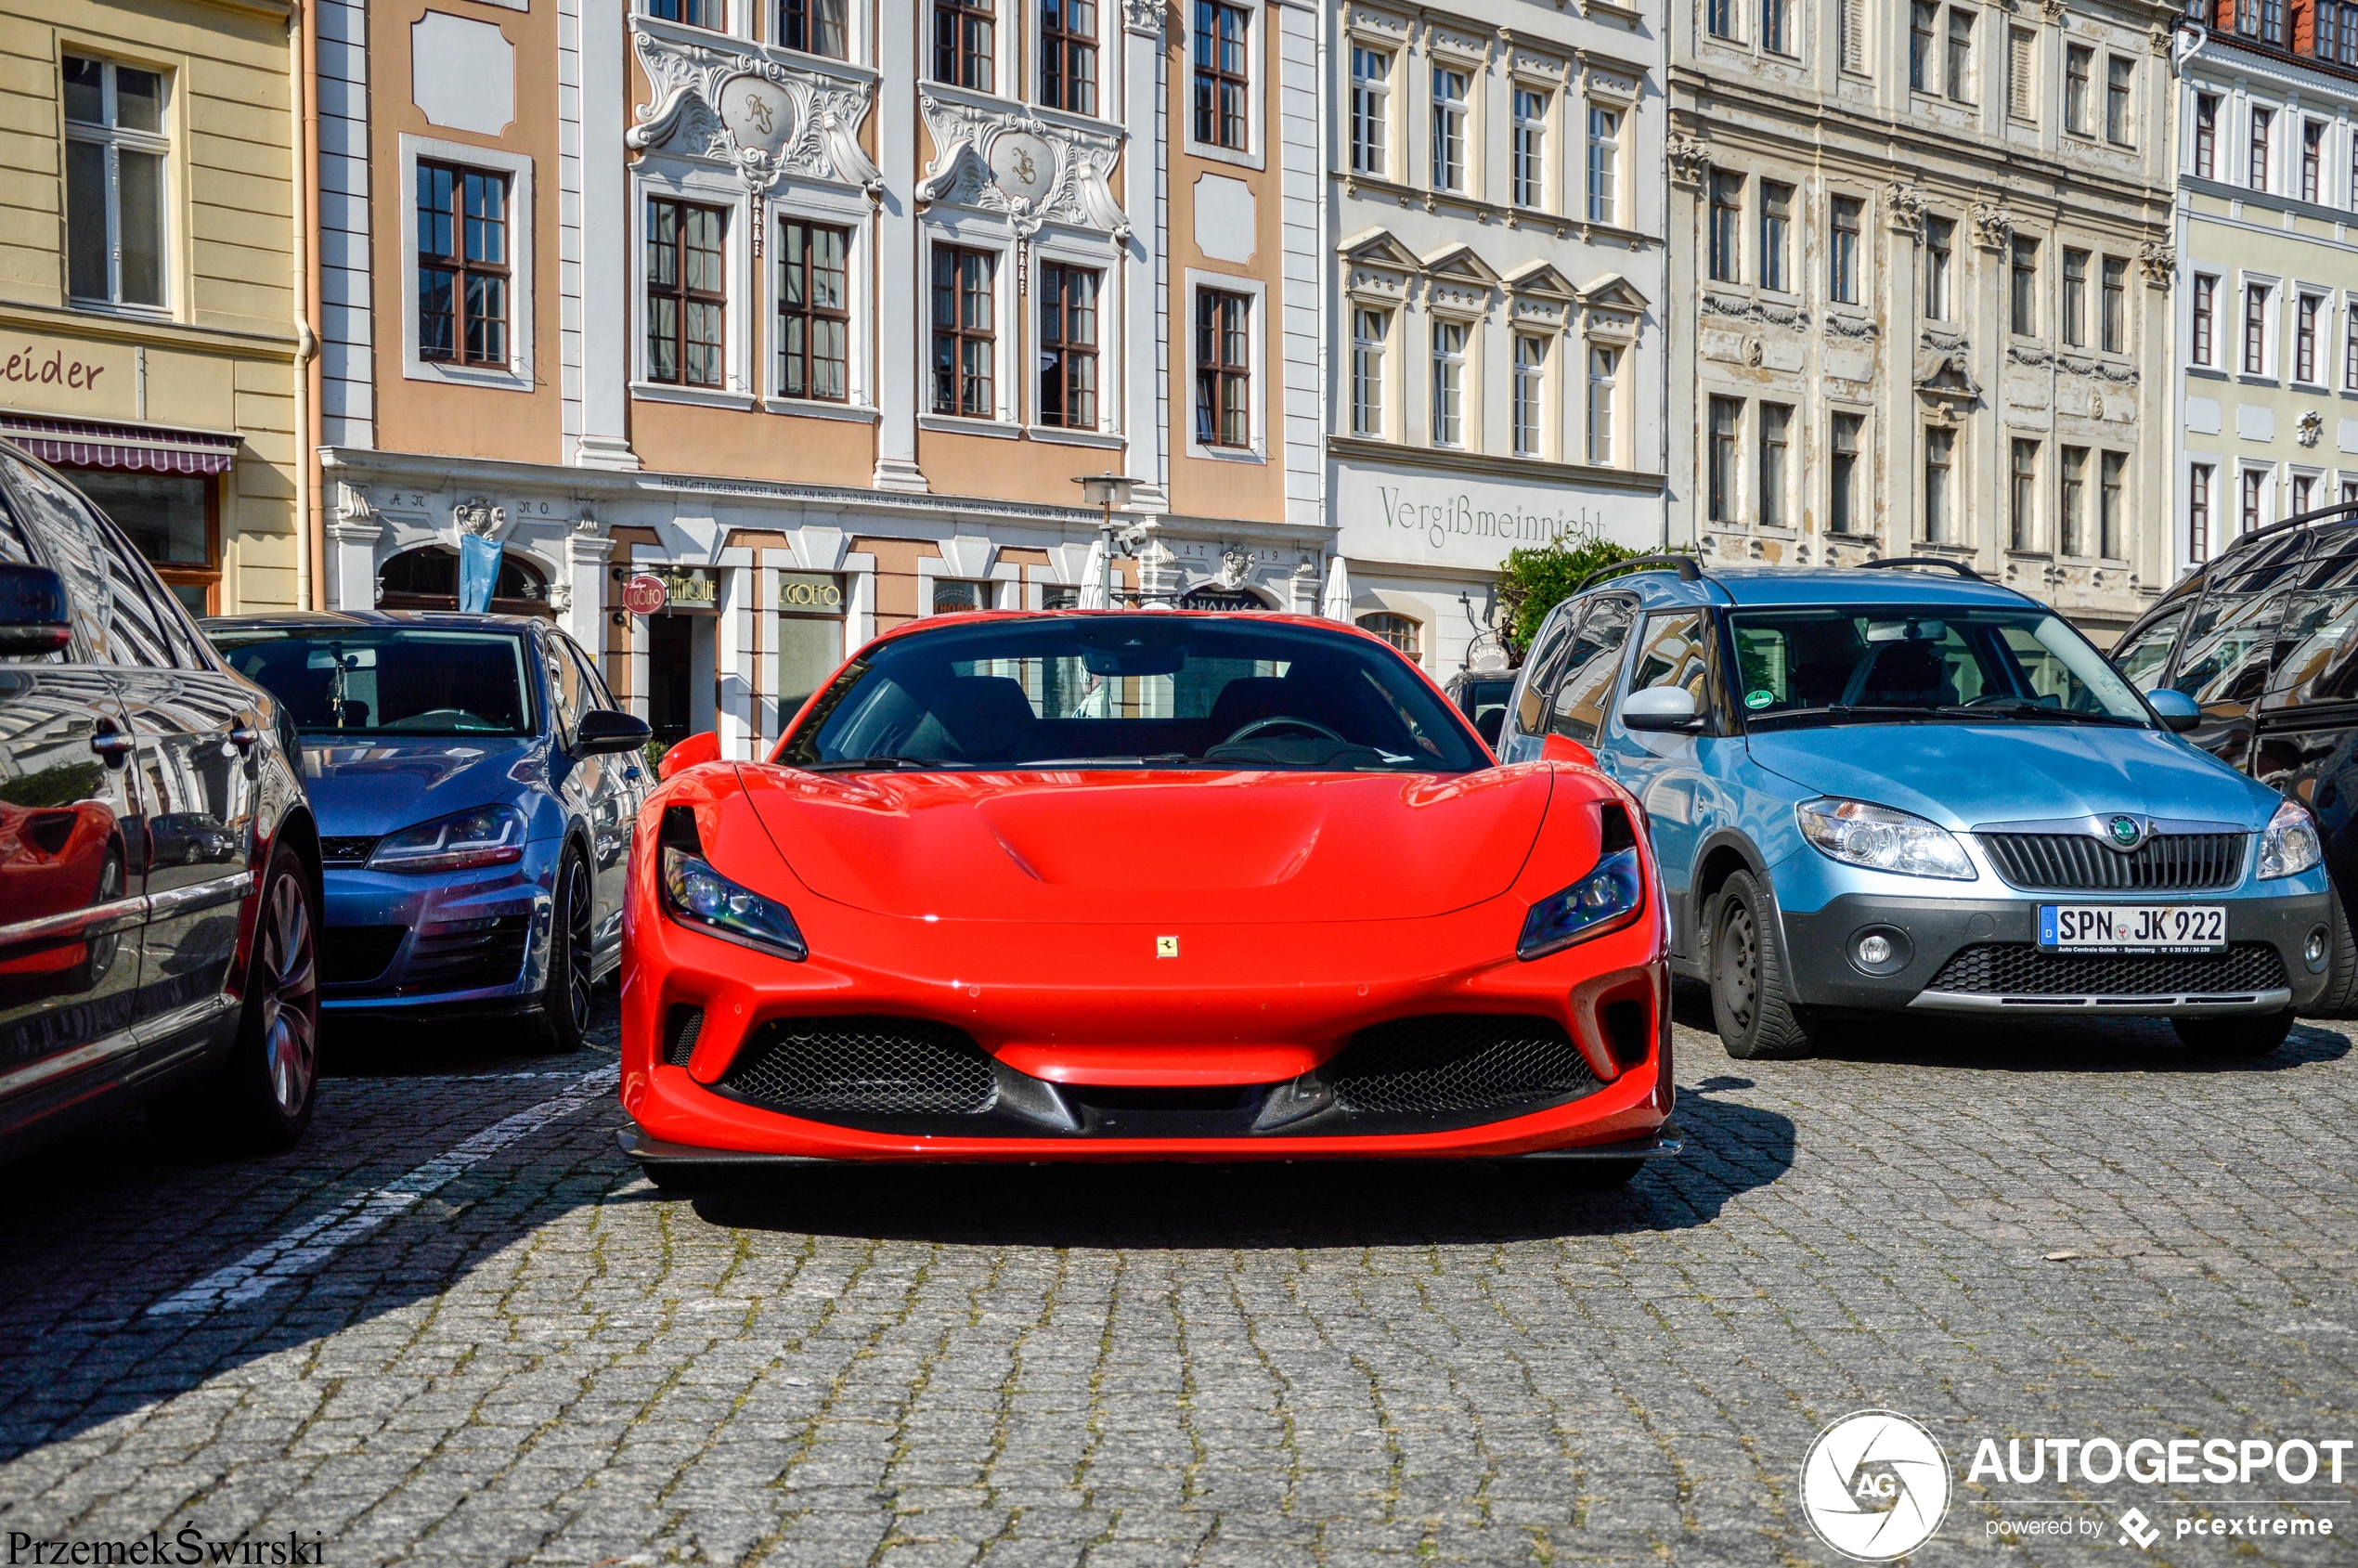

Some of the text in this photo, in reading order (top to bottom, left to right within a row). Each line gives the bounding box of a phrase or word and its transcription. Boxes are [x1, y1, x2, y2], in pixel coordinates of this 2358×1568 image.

[842, 492, 859, 502] UND
[1377, 486, 1606, 549] Vergißmeinnicht
[633, 589, 662, 605] GOLFO
[786, 584, 841, 606] GOLFO
[1755, 692, 1763, 700] 4
[2044, 910, 2222, 940] D SPN JK 922
